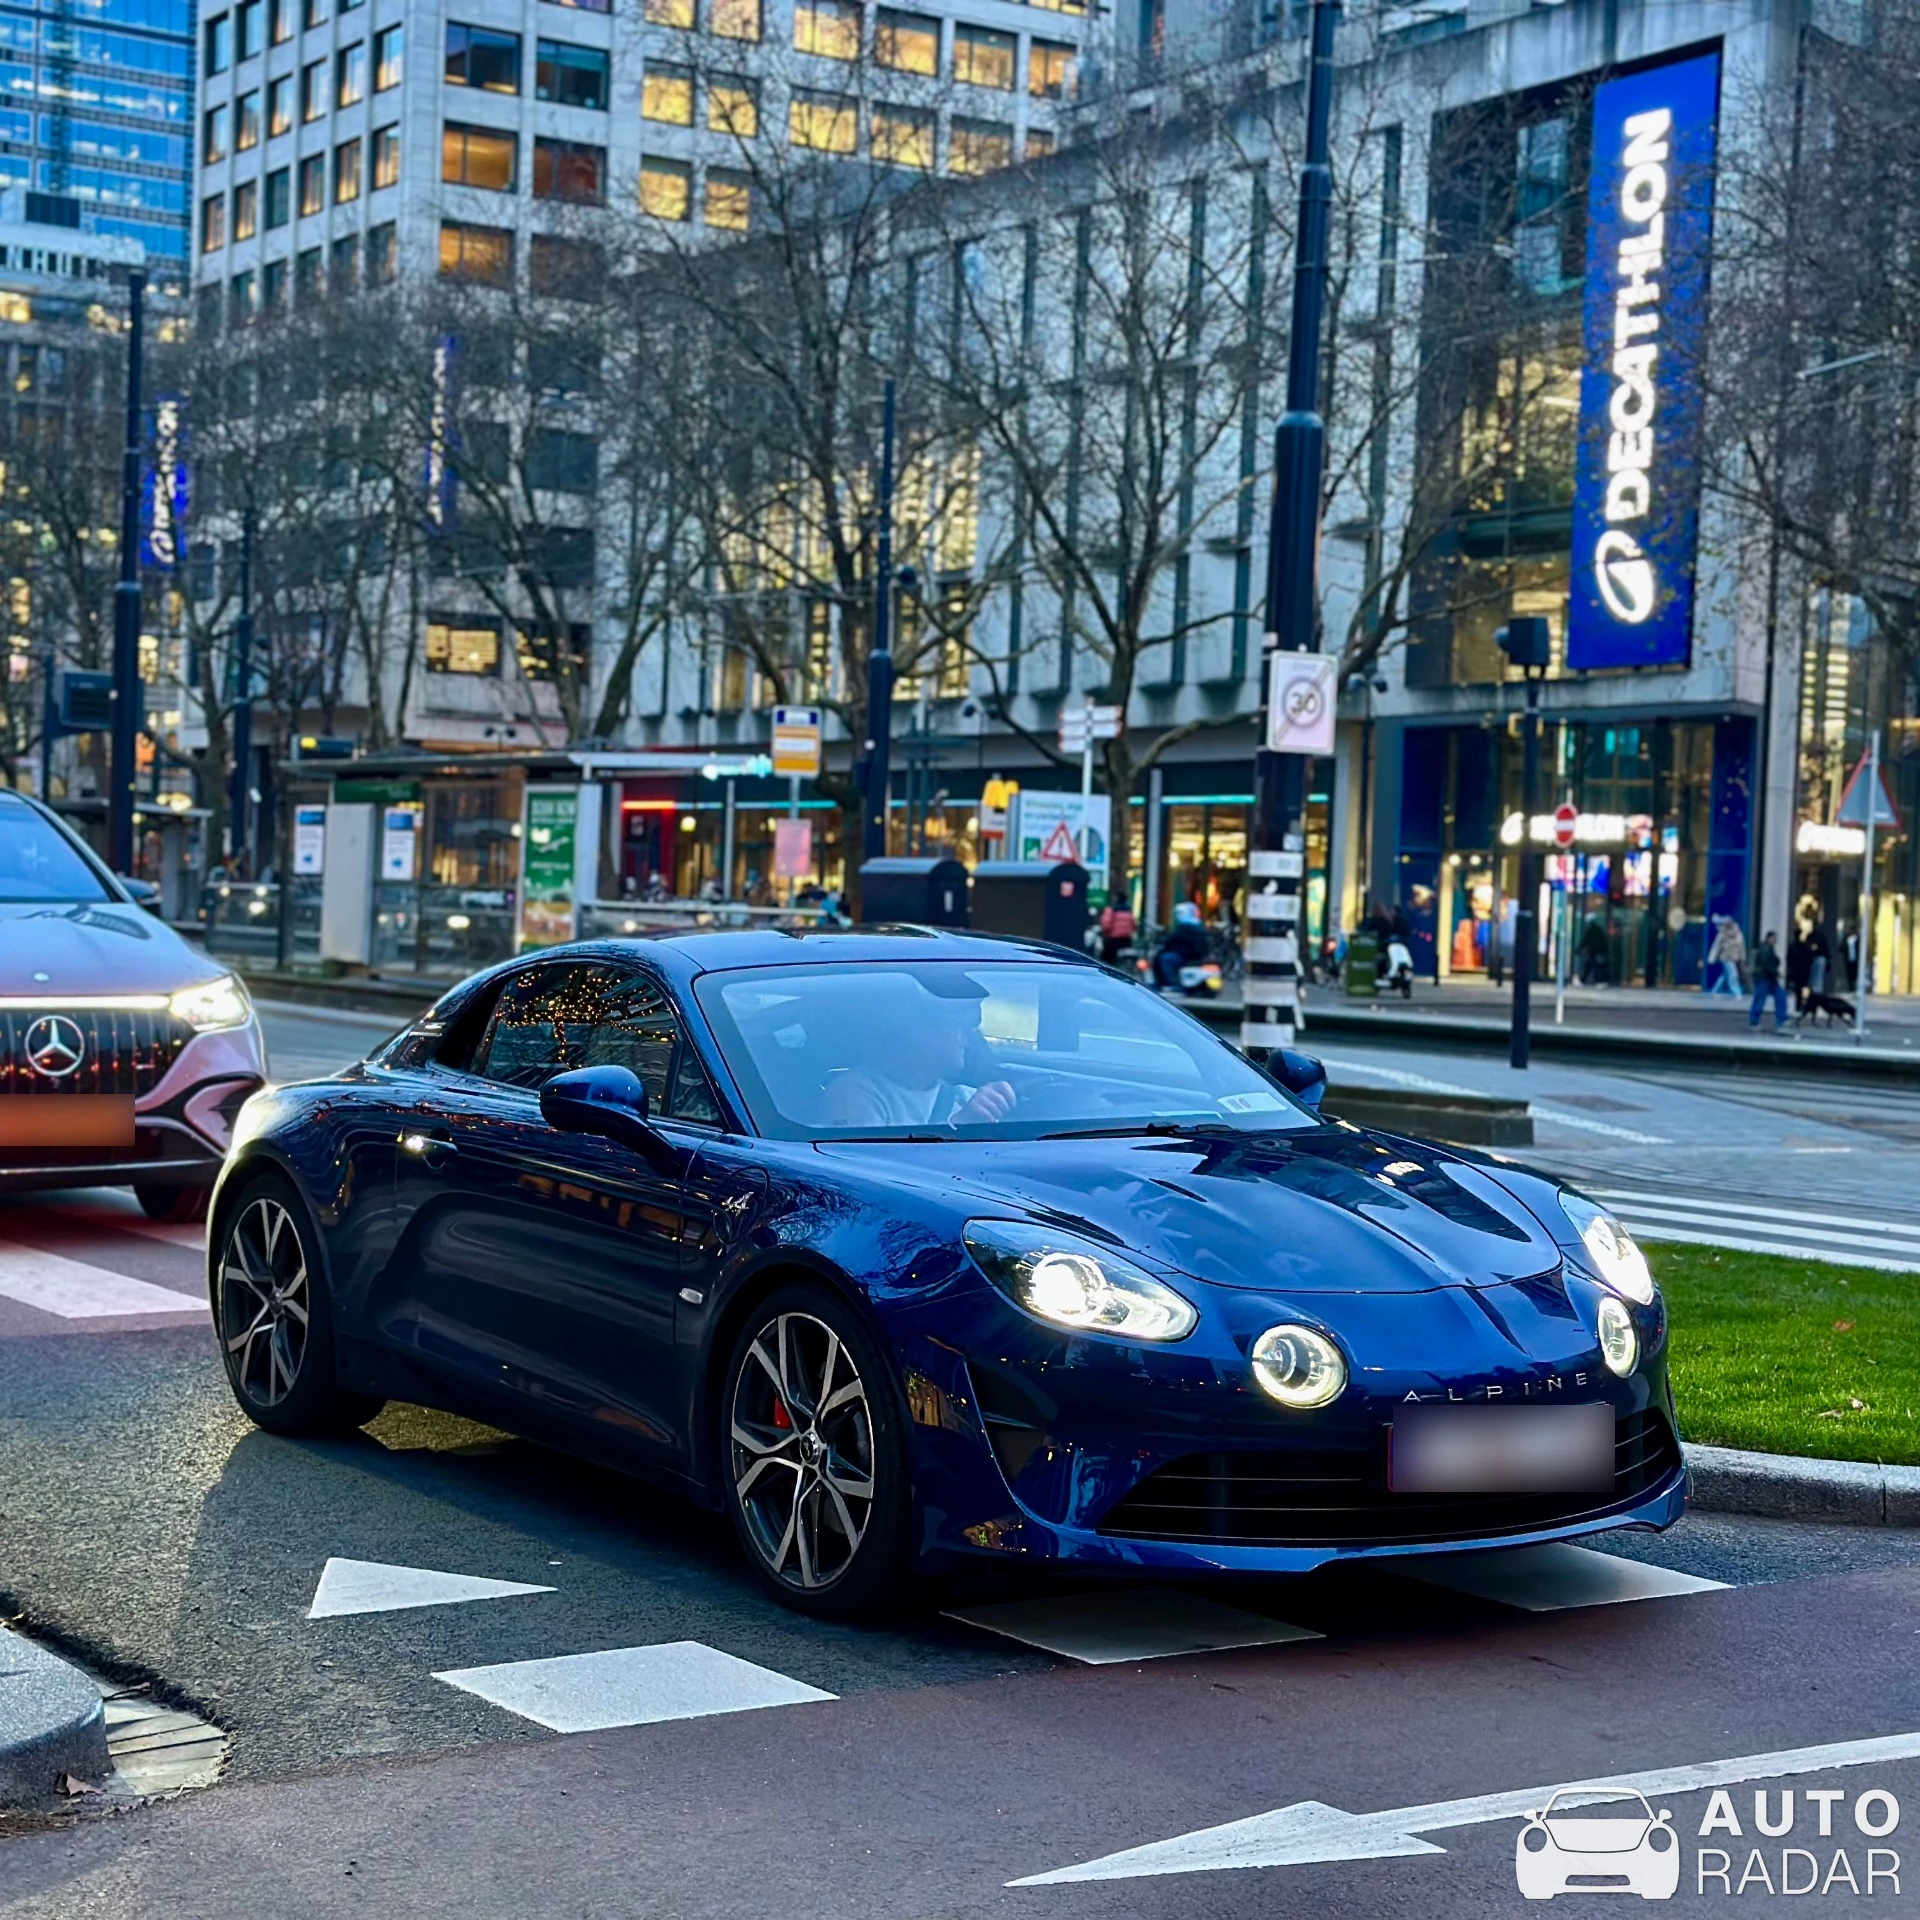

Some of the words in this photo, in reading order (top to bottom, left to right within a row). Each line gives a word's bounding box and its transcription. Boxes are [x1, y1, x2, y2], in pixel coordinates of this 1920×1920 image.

[1605, 108, 1671, 523] DECATHLON
[1291, 691, 1318, 714] 30
[1402, 1372, 1588, 1403] ALPINE
